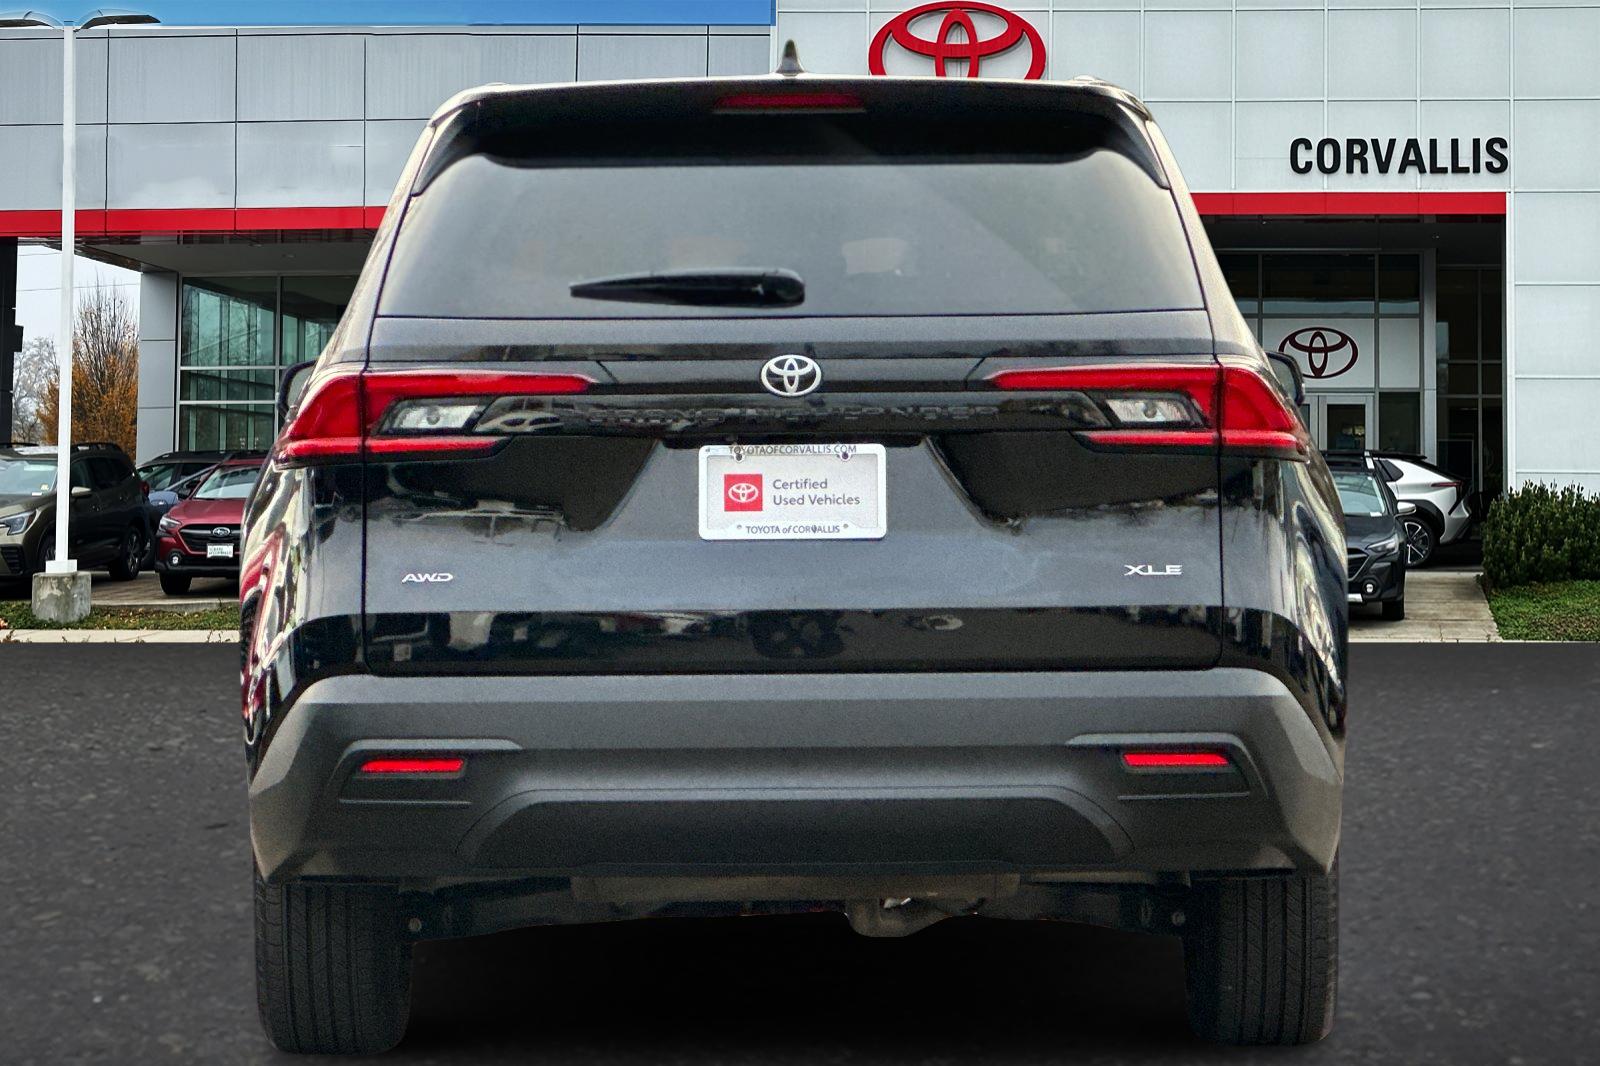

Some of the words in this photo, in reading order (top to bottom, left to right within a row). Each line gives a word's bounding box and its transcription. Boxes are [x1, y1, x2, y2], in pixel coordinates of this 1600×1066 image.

[1290, 137, 1509, 174] CORVALLIS
[773, 479, 827, 490] Certified
[773, 495, 804, 506] Used
[808, 495, 860, 505] Vehicles
[746, 526, 780, 534] TOYOTA
[782, 526, 792, 534] of
[1124, 565, 1182, 576] XLE
[402, 573, 453, 583] AWD
